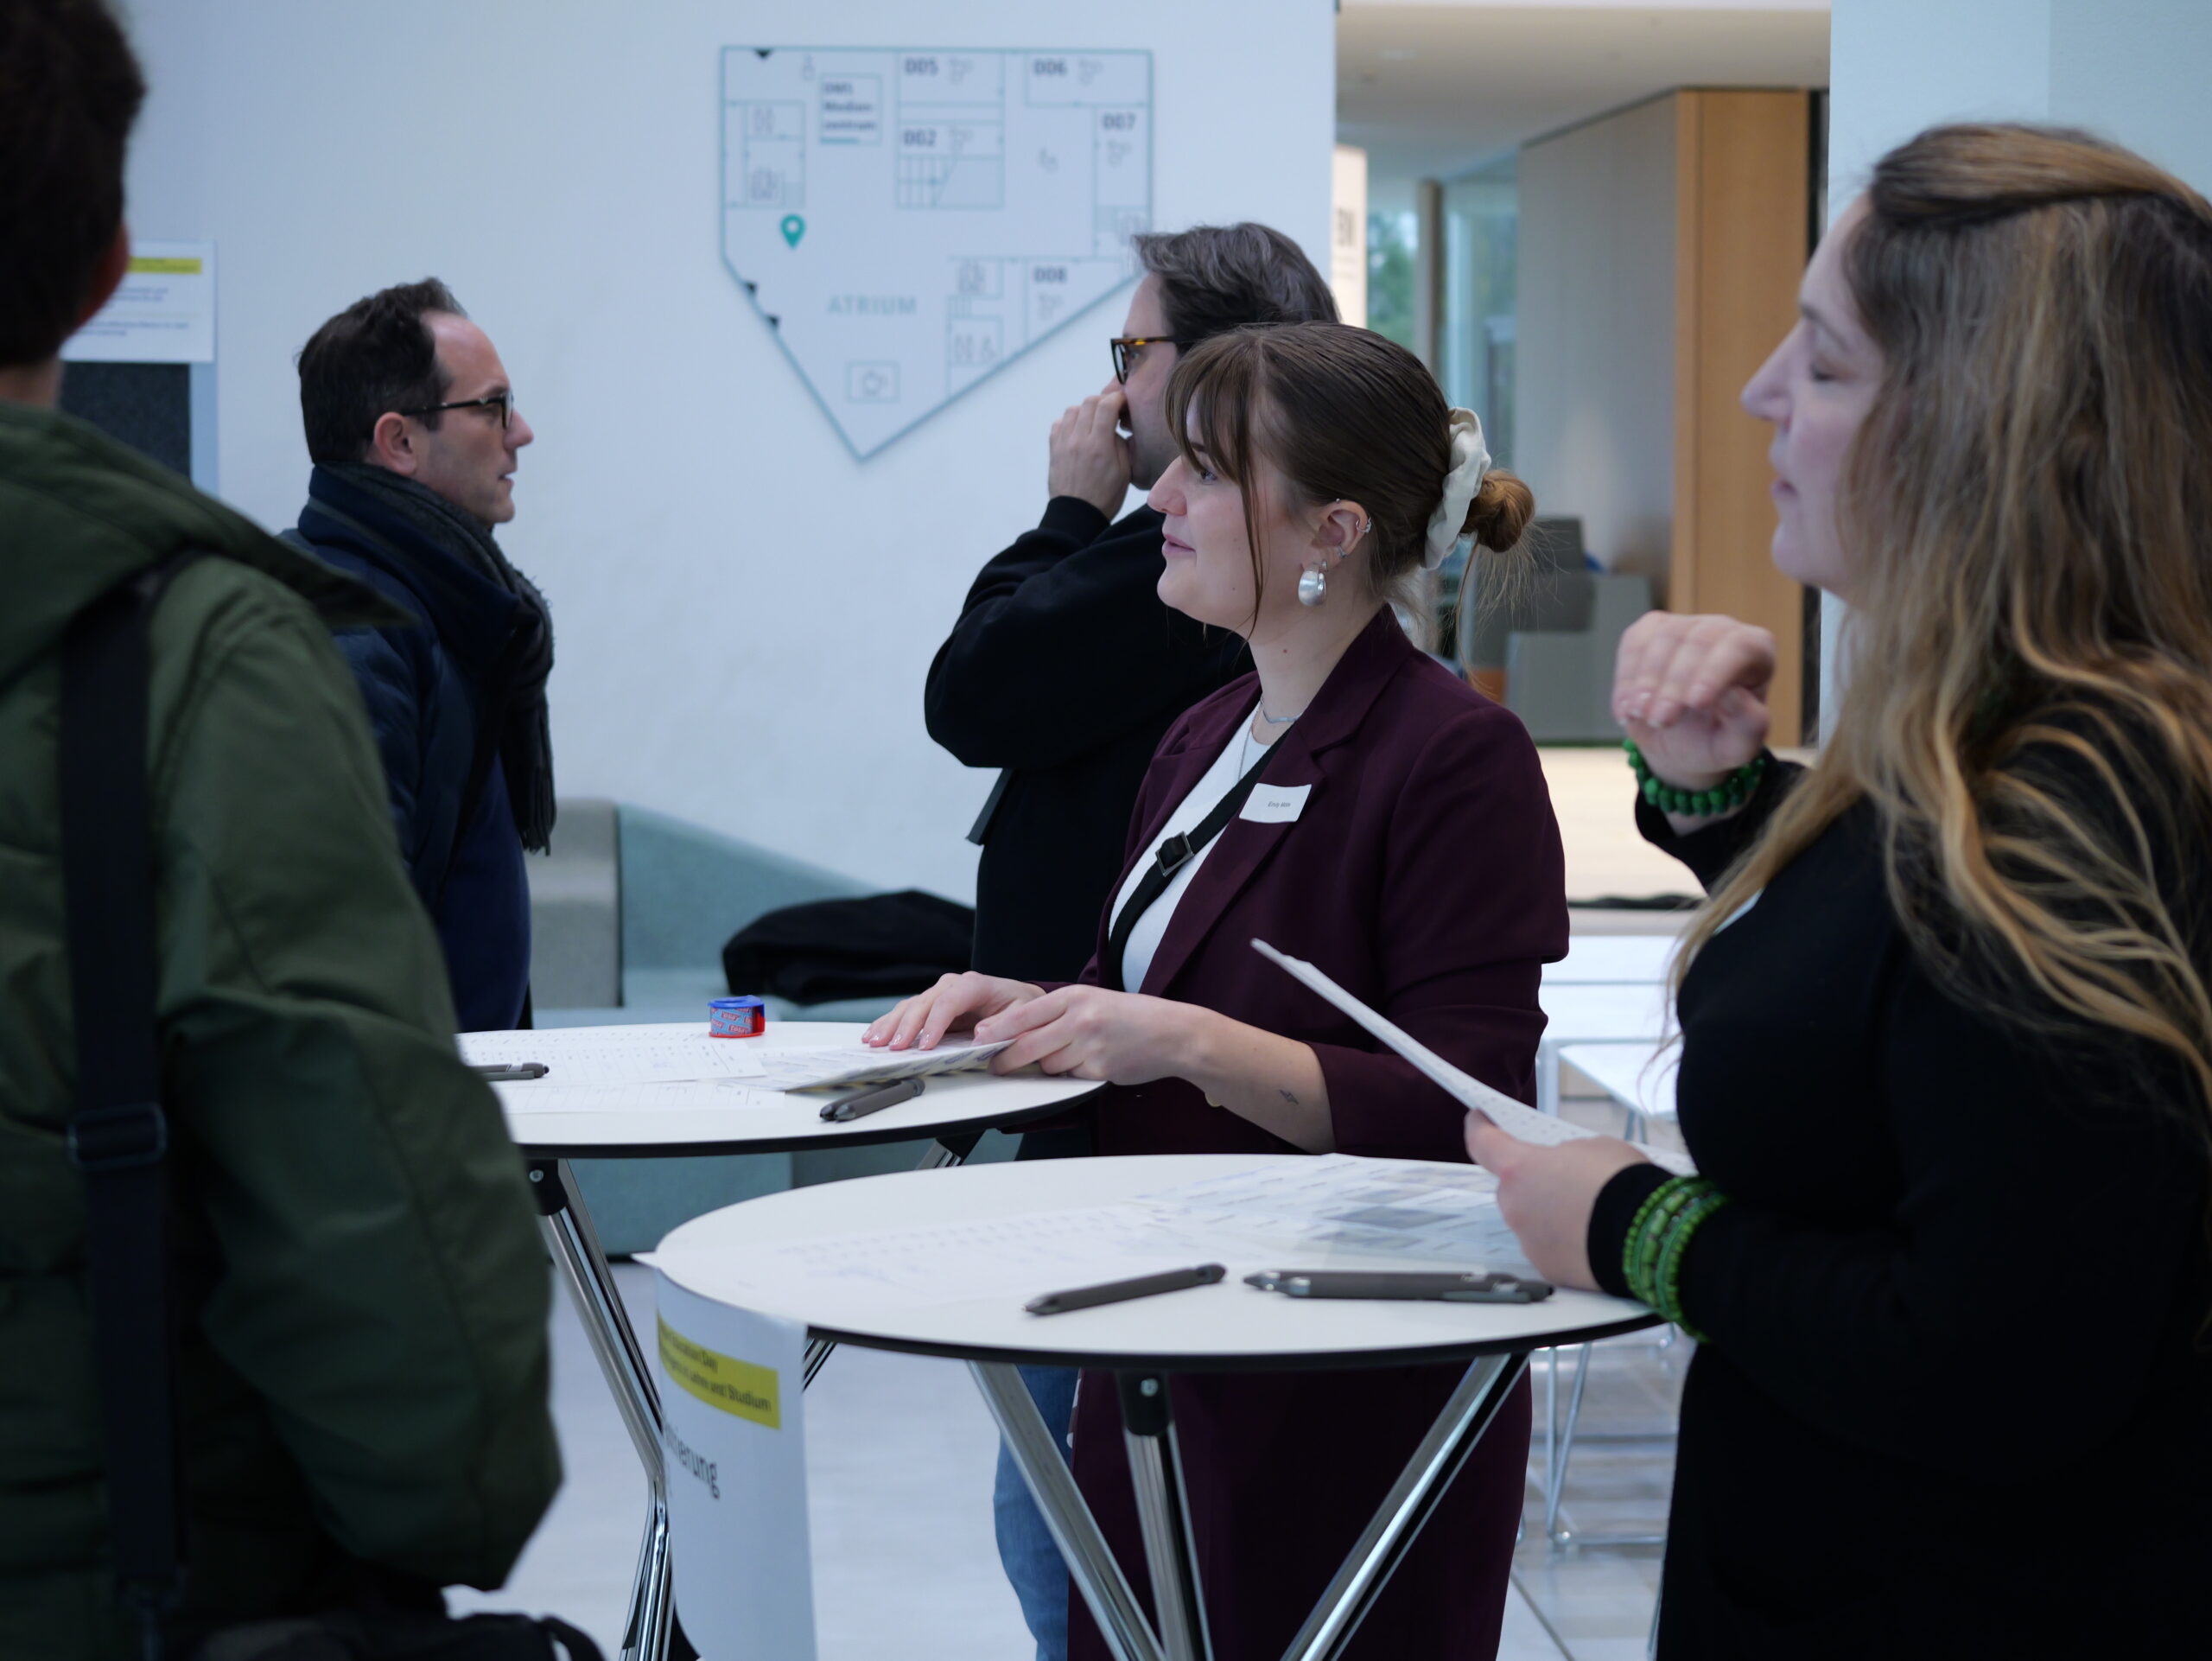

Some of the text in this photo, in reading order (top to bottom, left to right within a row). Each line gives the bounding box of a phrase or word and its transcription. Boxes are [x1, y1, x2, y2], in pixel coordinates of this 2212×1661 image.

[905, 57, 938, 75] 005
[1033, 58, 1067, 76] 006
[1103, 113, 1135, 130] 007
[903, 129, 936, 146] 002
[826, 296, 918, 315] ATRIUM
[728, 1384, 772, 1412] Studium
